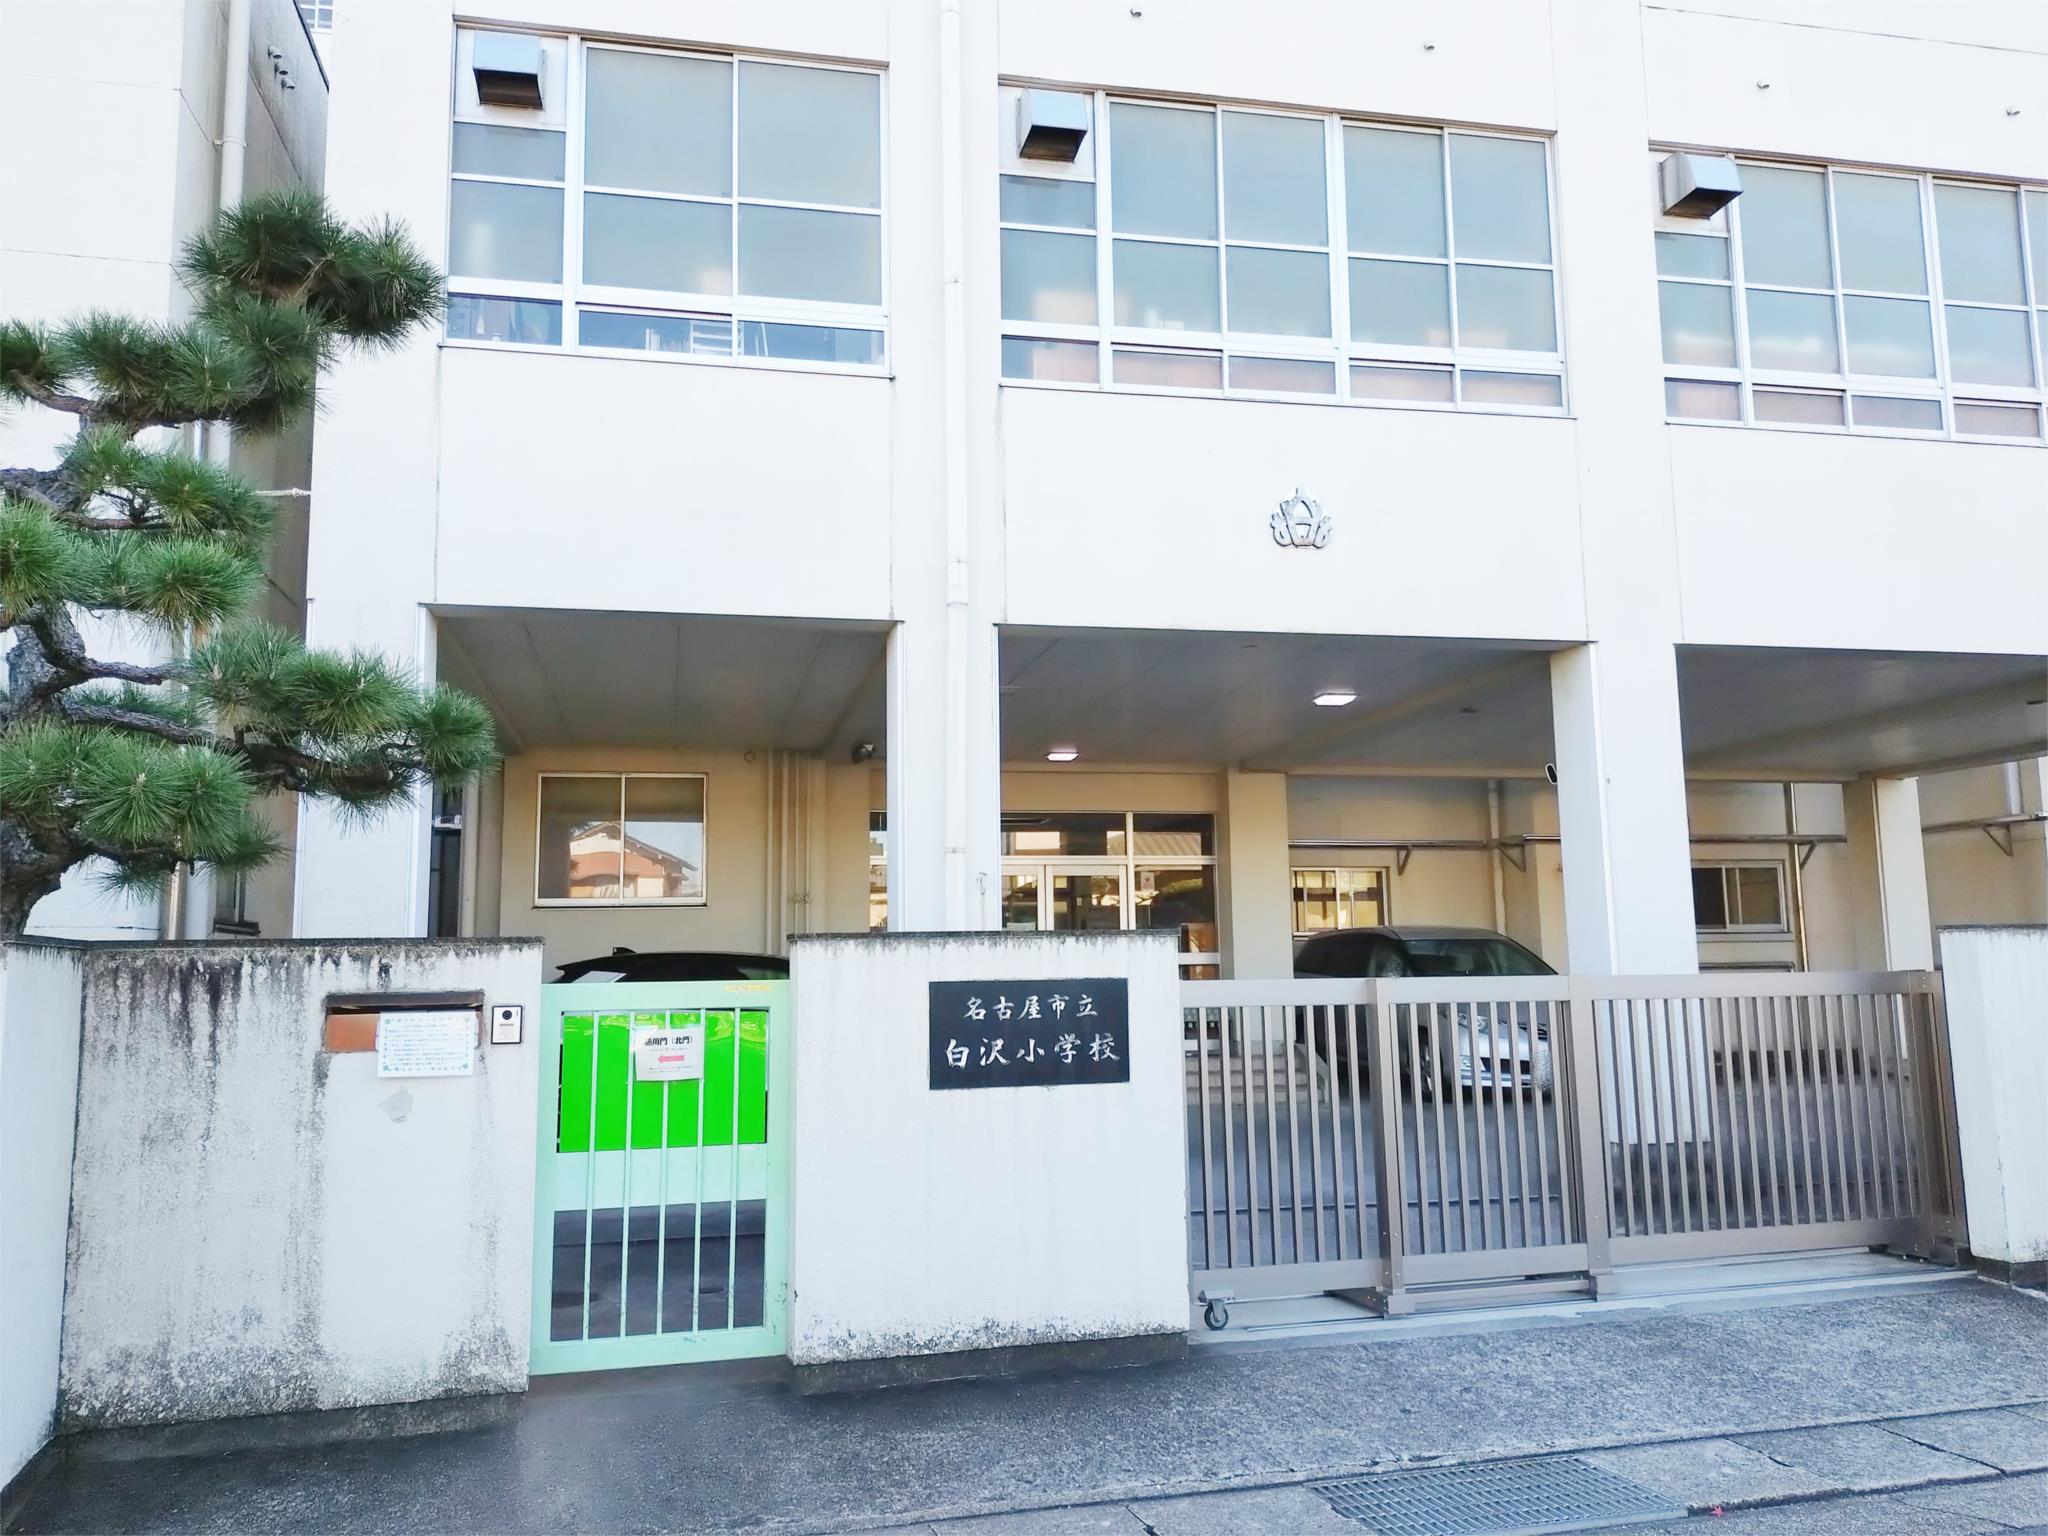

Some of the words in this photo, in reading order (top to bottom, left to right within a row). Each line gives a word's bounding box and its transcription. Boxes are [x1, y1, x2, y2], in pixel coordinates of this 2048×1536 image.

[963, 993, 1098, 1021] 名古屋市立
[945, 1033, 1120, 1069] 白沢小学校
